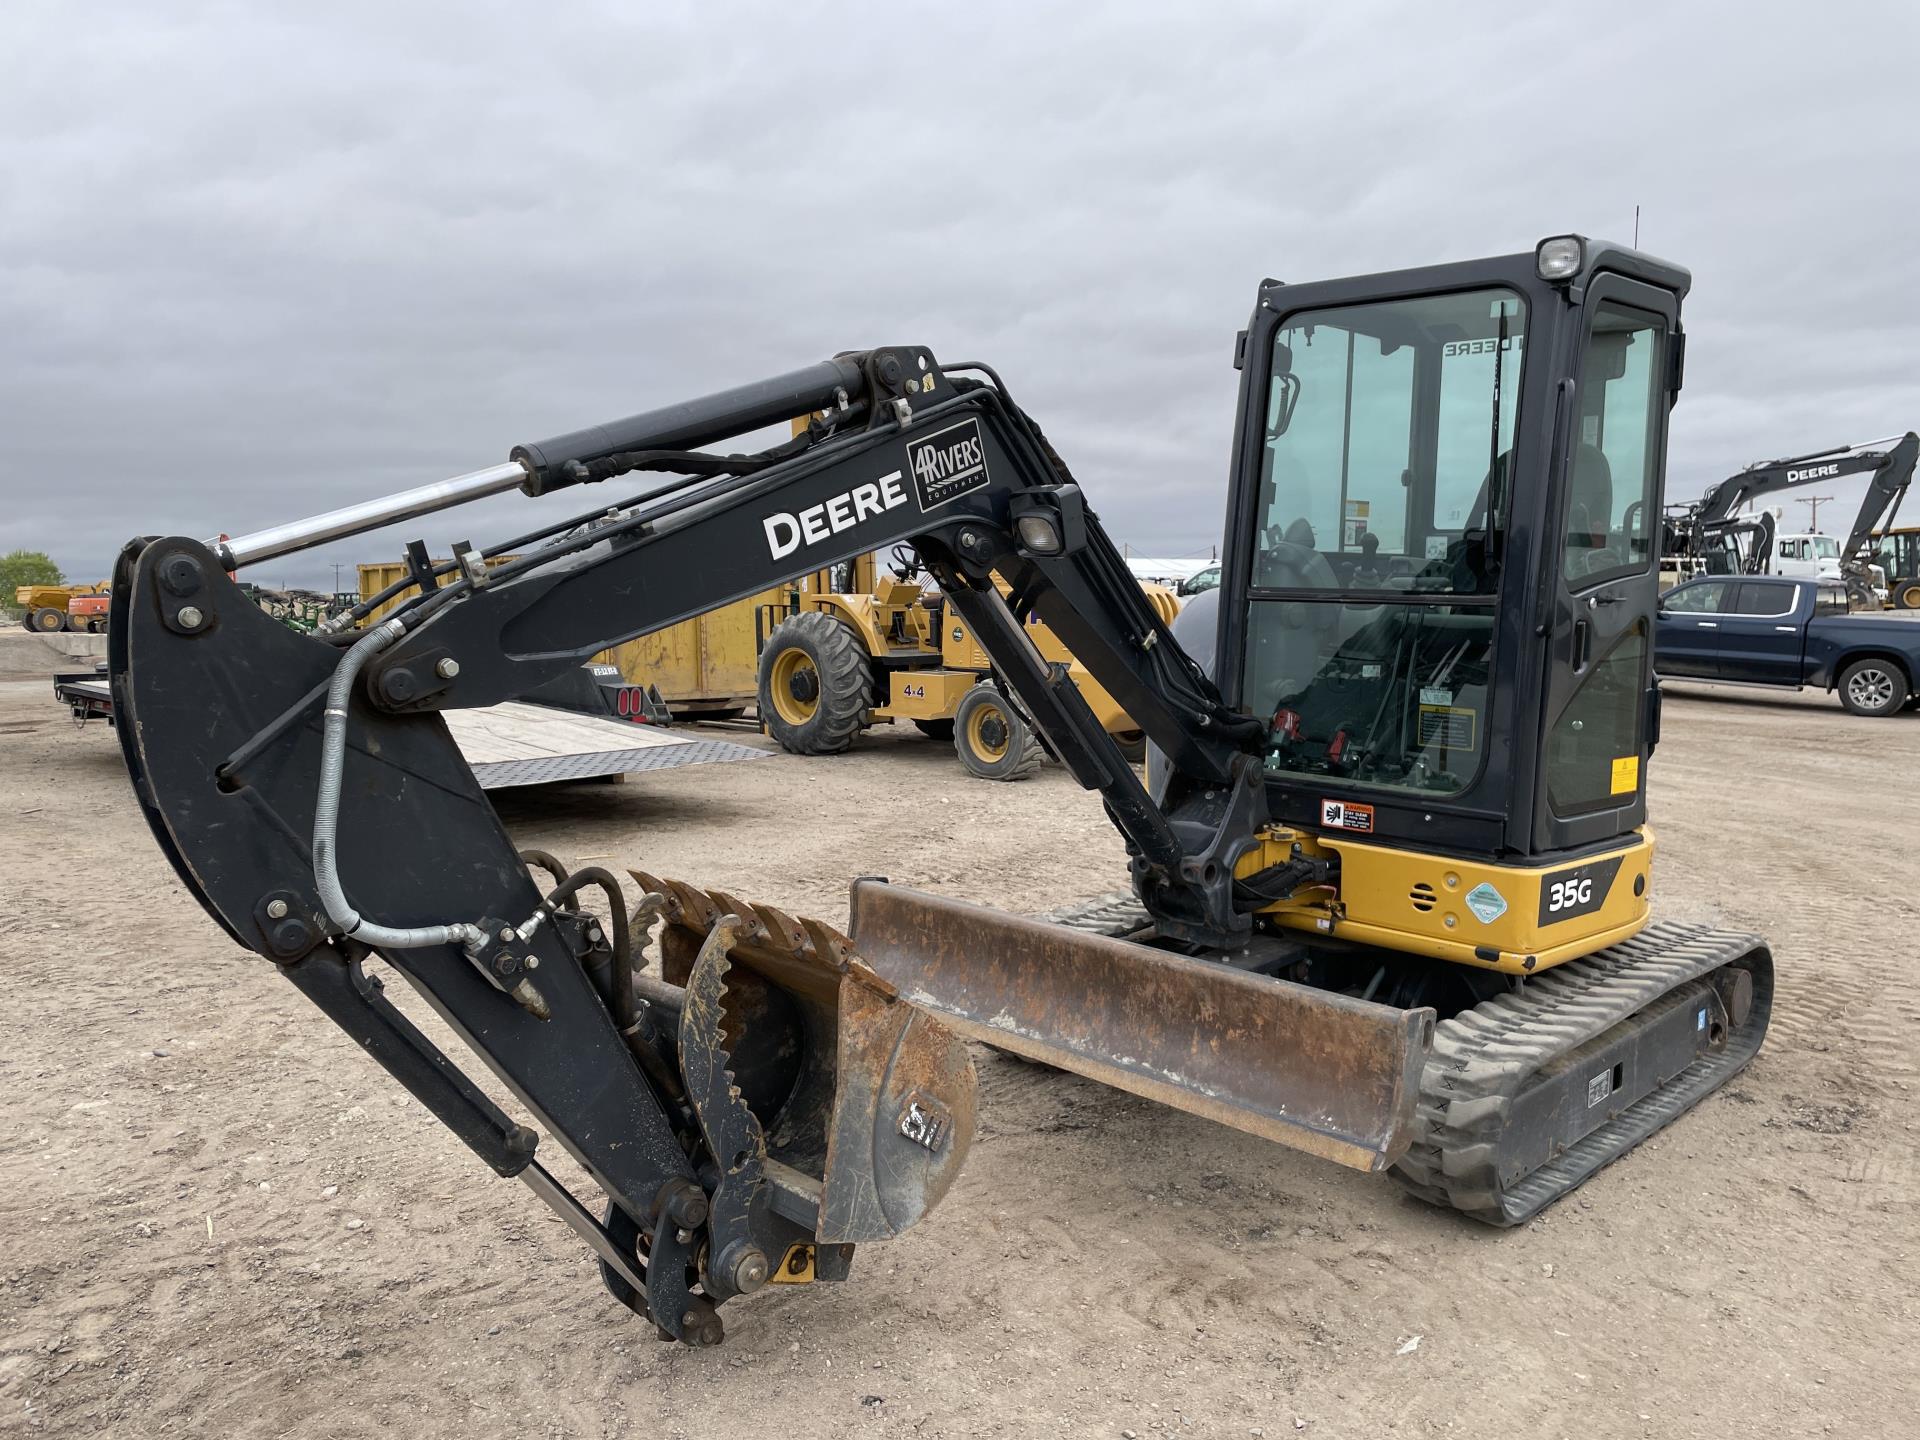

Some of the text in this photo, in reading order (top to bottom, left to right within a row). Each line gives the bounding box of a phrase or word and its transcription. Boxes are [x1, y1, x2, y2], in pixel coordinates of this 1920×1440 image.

[928, 472, 985, 501] EQUIPMENT
[1786, 463, 1839, 483] DEERE
[762, 470, 908, 561] DEERE
[1548, 878, 1592, 912] 35G
